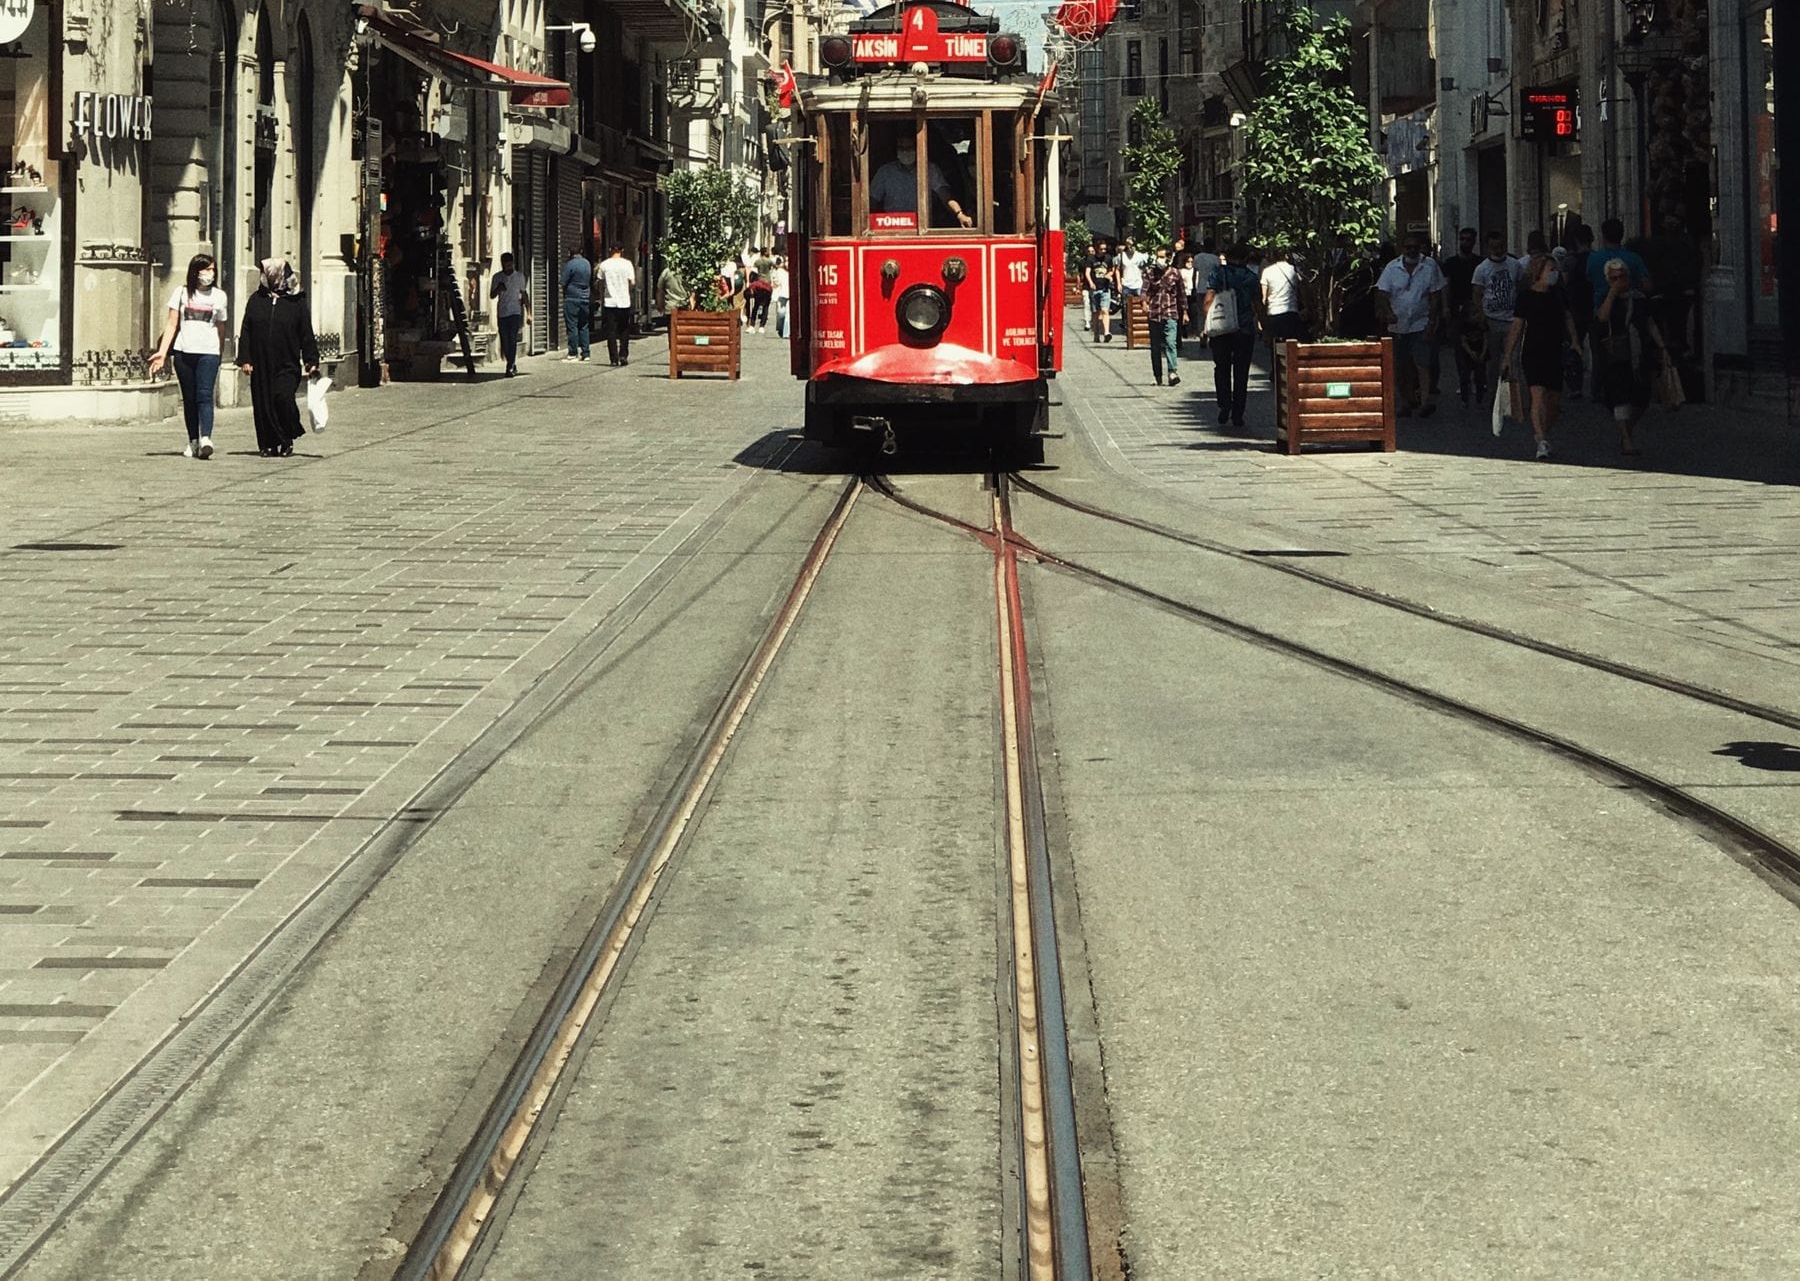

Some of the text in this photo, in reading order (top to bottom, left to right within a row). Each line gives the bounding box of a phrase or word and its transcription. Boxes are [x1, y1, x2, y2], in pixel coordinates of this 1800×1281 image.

[912, 9, 924, 31] 4
[74, 91, 153, 141] FLOWER
[876, 216, 915, 226] TÜNEL
[818, 265, 838, 286] 115
[1008, 261, 1029, 283] 115
